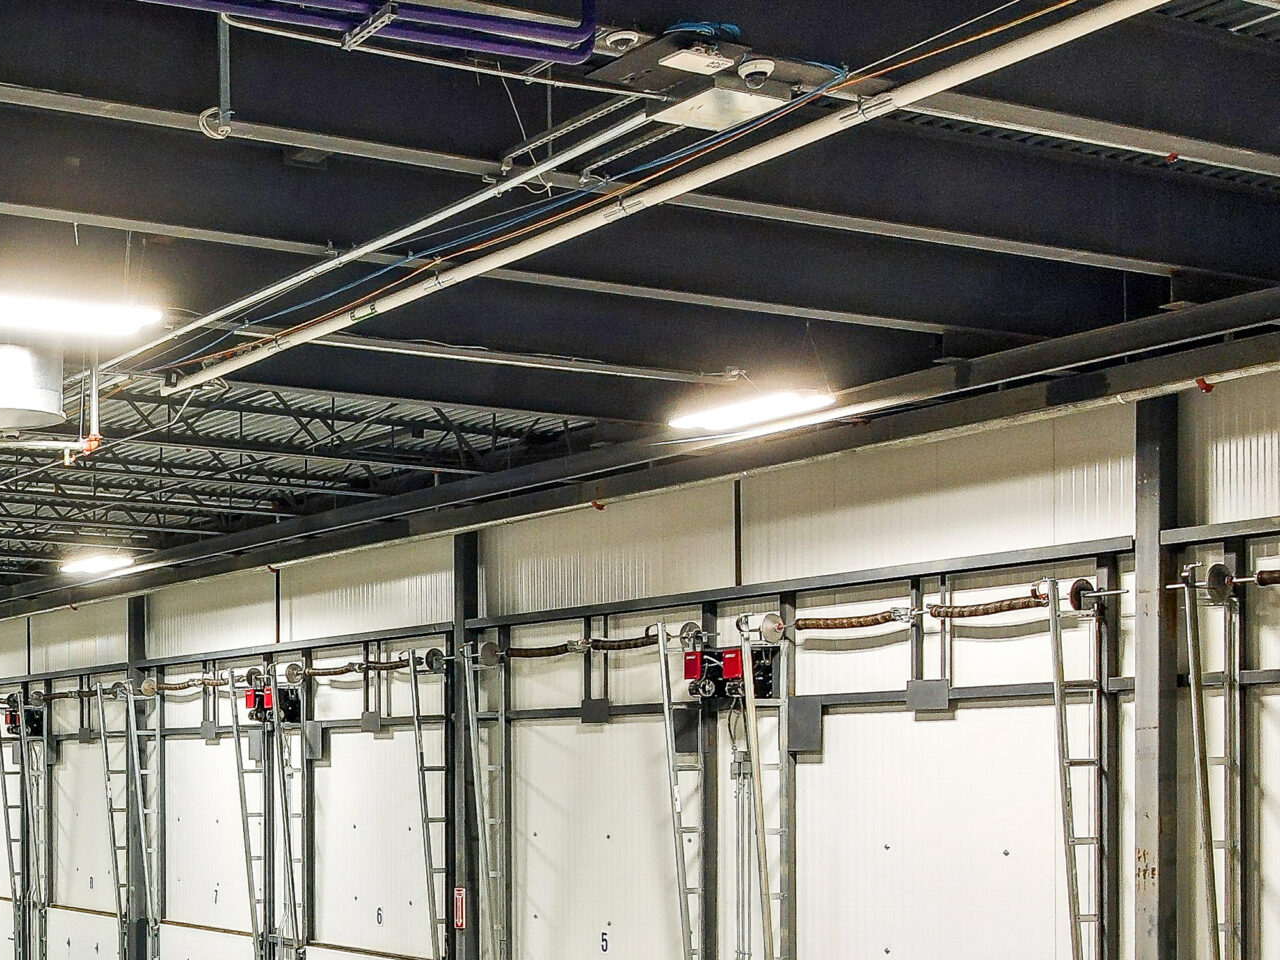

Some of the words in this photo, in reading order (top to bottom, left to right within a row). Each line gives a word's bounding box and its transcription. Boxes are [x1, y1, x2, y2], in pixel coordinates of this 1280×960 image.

[214, 889, 218, 904] 7
[376, 907, 383, 925] 6
[601, 932, 608, 952] 5
